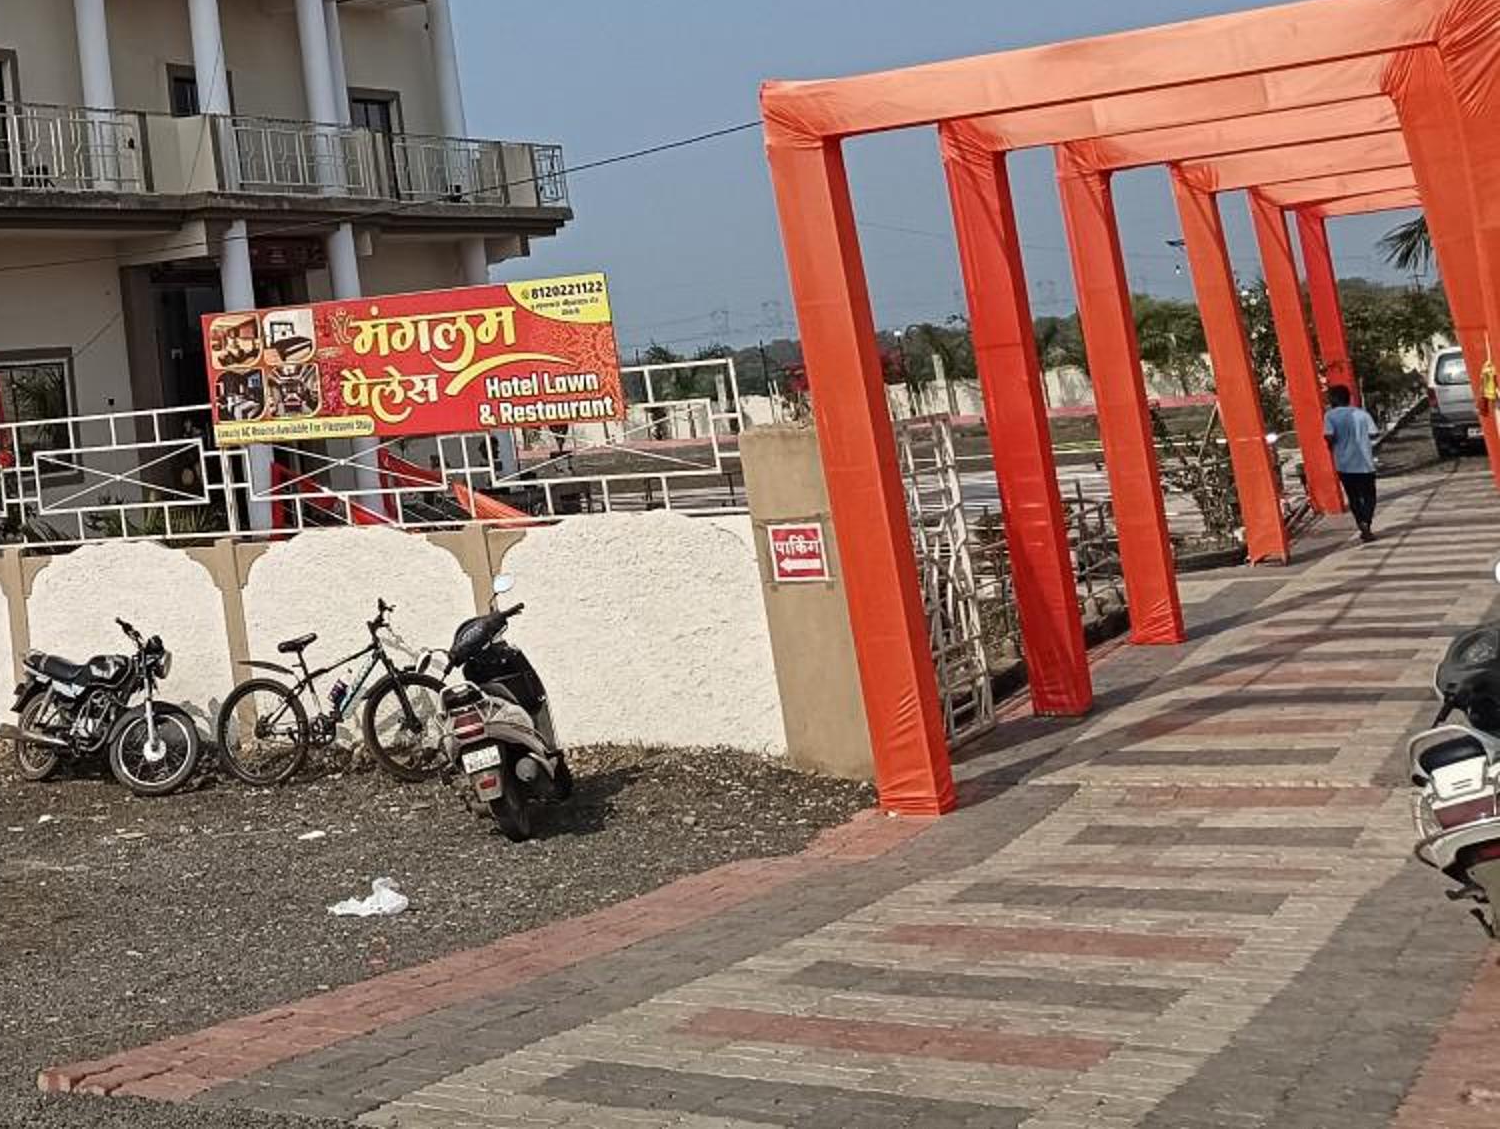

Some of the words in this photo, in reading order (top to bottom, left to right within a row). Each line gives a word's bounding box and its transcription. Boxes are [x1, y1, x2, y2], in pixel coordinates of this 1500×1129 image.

[531, 280, 603, 300] 8120221122
[350, 305, 517, 373] मंगलम
[340, 365, 440, 423] पैलेस
[485, 374, 539, 399] Hotel
[543, 371, 599, 395] Lawn
[479, 402, 497, 426] &
[499, 395, 615, 424] Restaurant
[774, 534, 820, 556] पार्किंग
